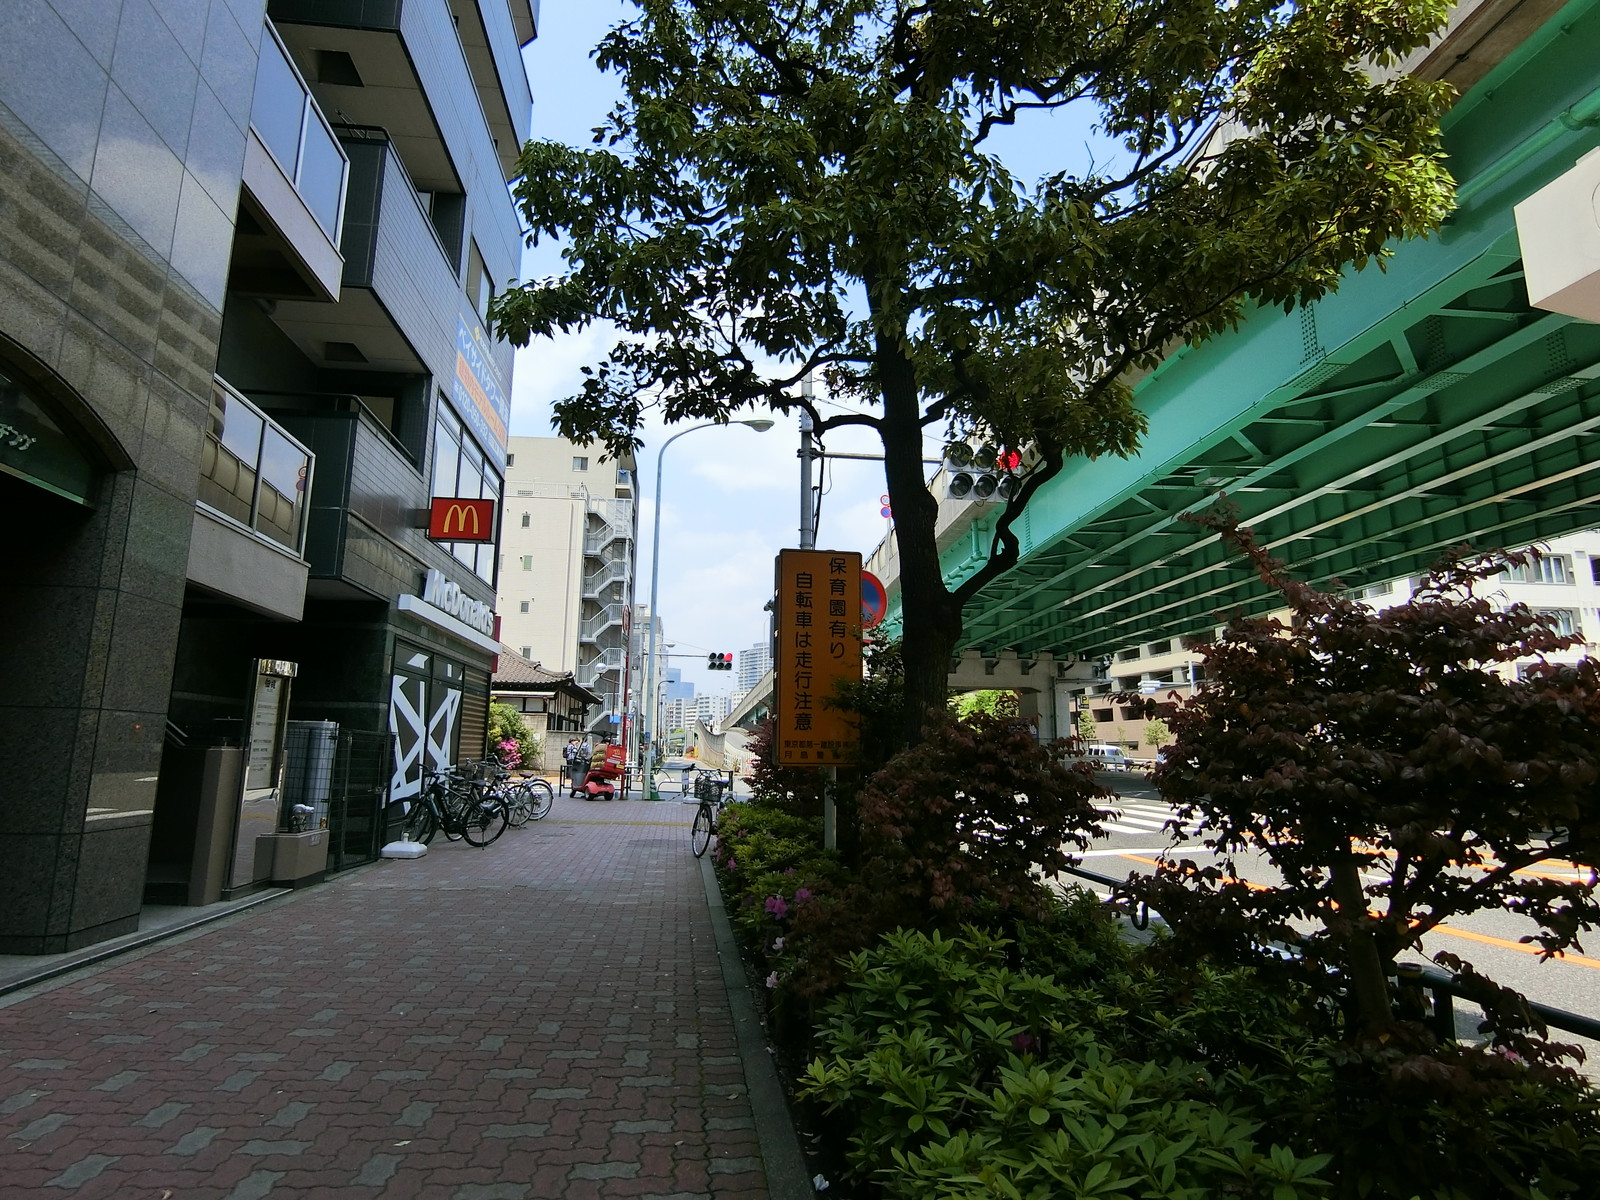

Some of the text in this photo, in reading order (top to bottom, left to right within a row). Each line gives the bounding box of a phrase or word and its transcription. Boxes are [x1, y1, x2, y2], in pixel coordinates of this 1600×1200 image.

[794, 571, 813, 732] 自転車は走行注意
[829, 557, 847, 660] 保育園有り
